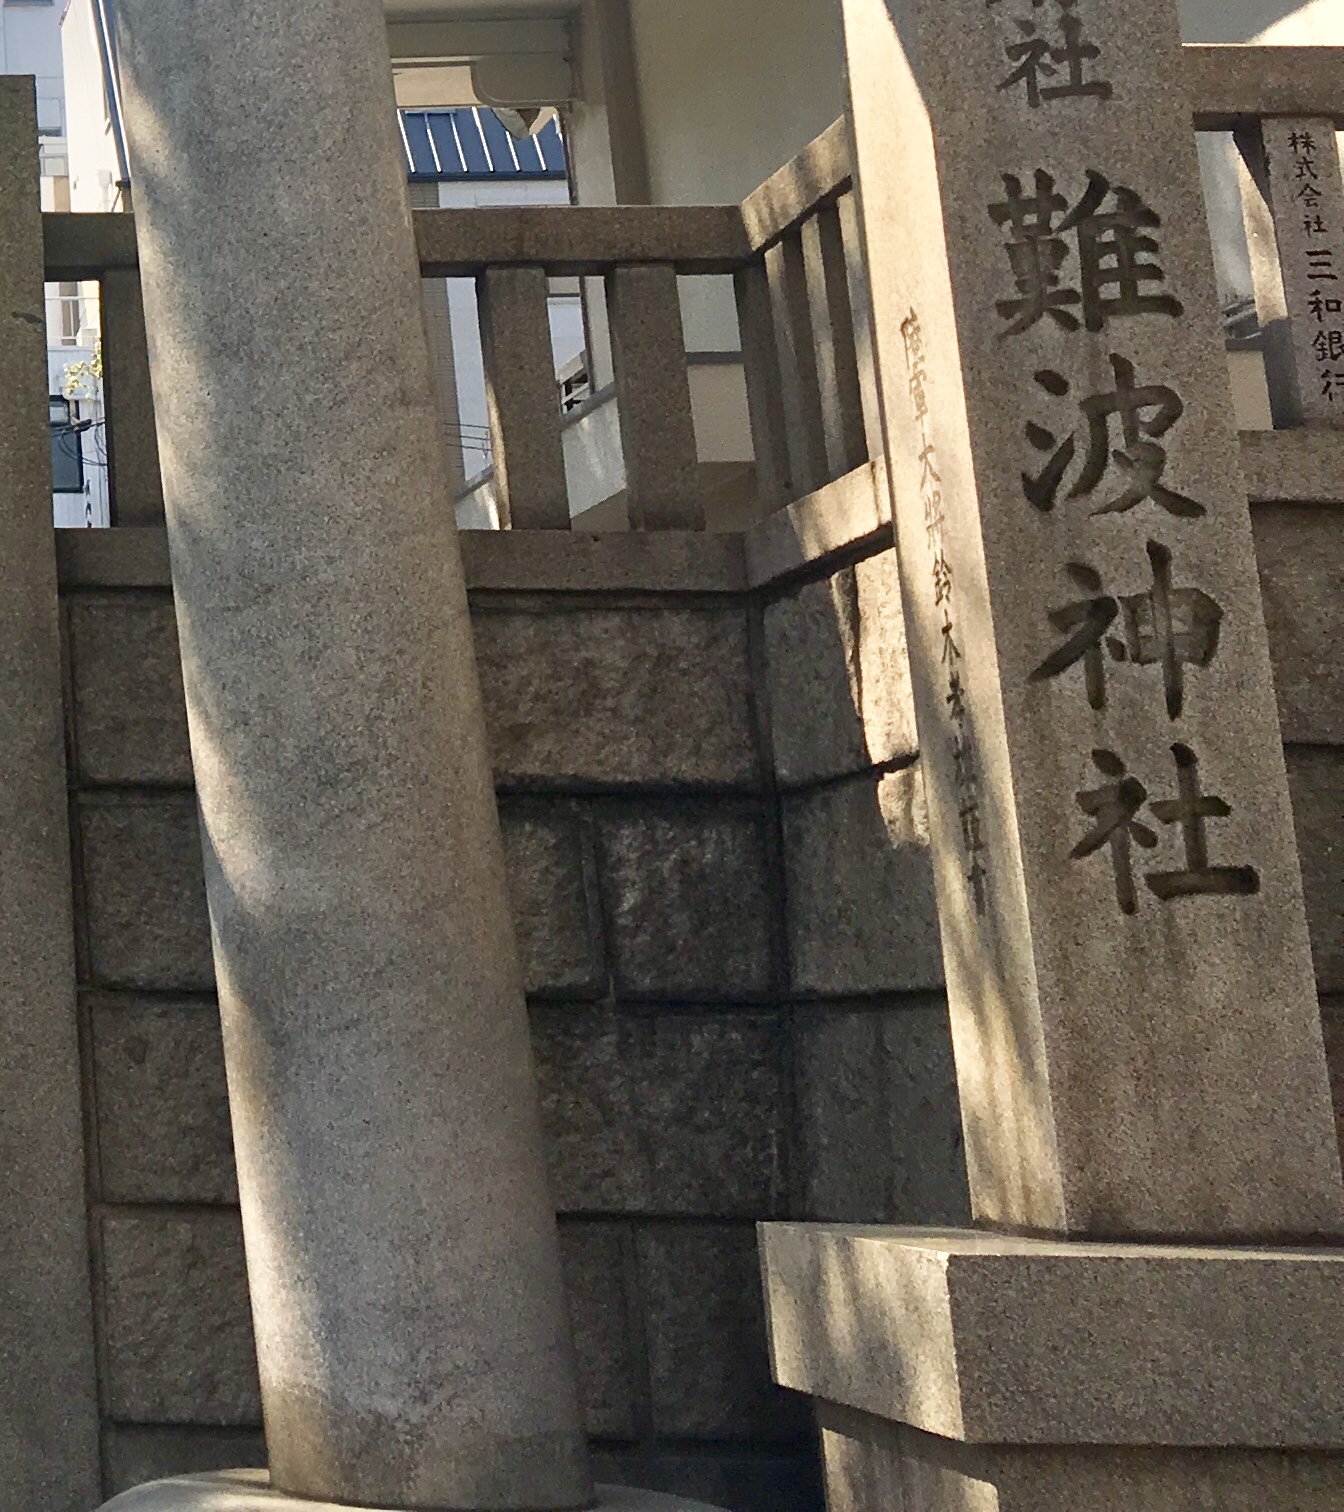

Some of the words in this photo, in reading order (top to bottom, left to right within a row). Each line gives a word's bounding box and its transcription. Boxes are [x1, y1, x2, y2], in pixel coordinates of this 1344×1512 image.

[1286, 130, 1344, 403] 株式会社三和銀行
